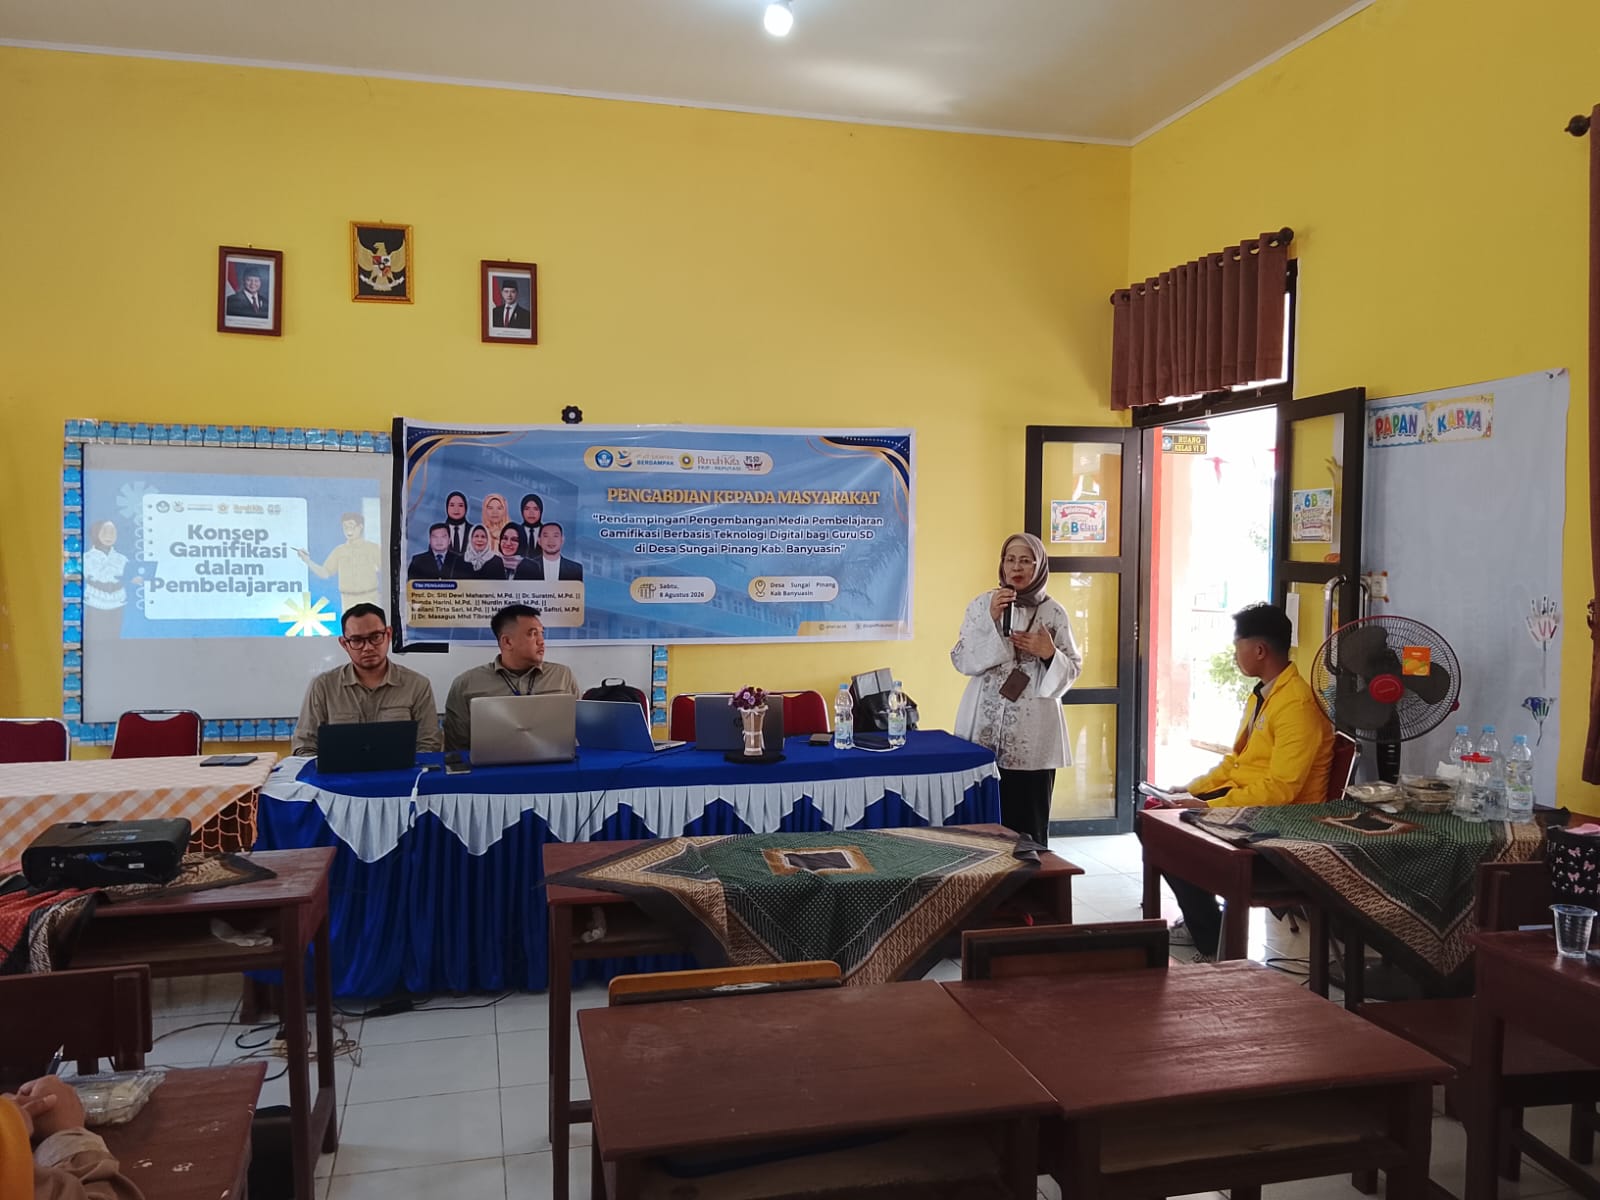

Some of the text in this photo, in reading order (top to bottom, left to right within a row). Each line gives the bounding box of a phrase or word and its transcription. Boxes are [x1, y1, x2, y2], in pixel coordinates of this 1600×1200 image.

[1375, 408, 1482, 438] PAPAN KARYA
[607, 487, 881, 506] PENGABDIAN KEPADA MASYARAKAT
[1304, 493, 1318, 508] 6B
[689, 514, 776, 527] Pengembangan
[779, 515, 810, 526] Media
[812, 516, 884, 528] Pembelajaran
[187, 524, 269, 545] Konsep
[600, 528, 874, 541] Gamifikasi Berbasis Teknologi Digital bagi Guru SD
[169, 541, 288, 559] Gamifikasi
[634, 544, 646, 553] di
[649, 544, 676, 554] Desa
[679, 545, 718, 556] Sungai
[720, 544, 759, 556] Pinang
[761, 545, 784, 554] Kab.
[194, 559, 264, 576] dalam
[149, 577, 303, 597] Pembelajaran
[783, 590, 814, 598] Banyuasin
